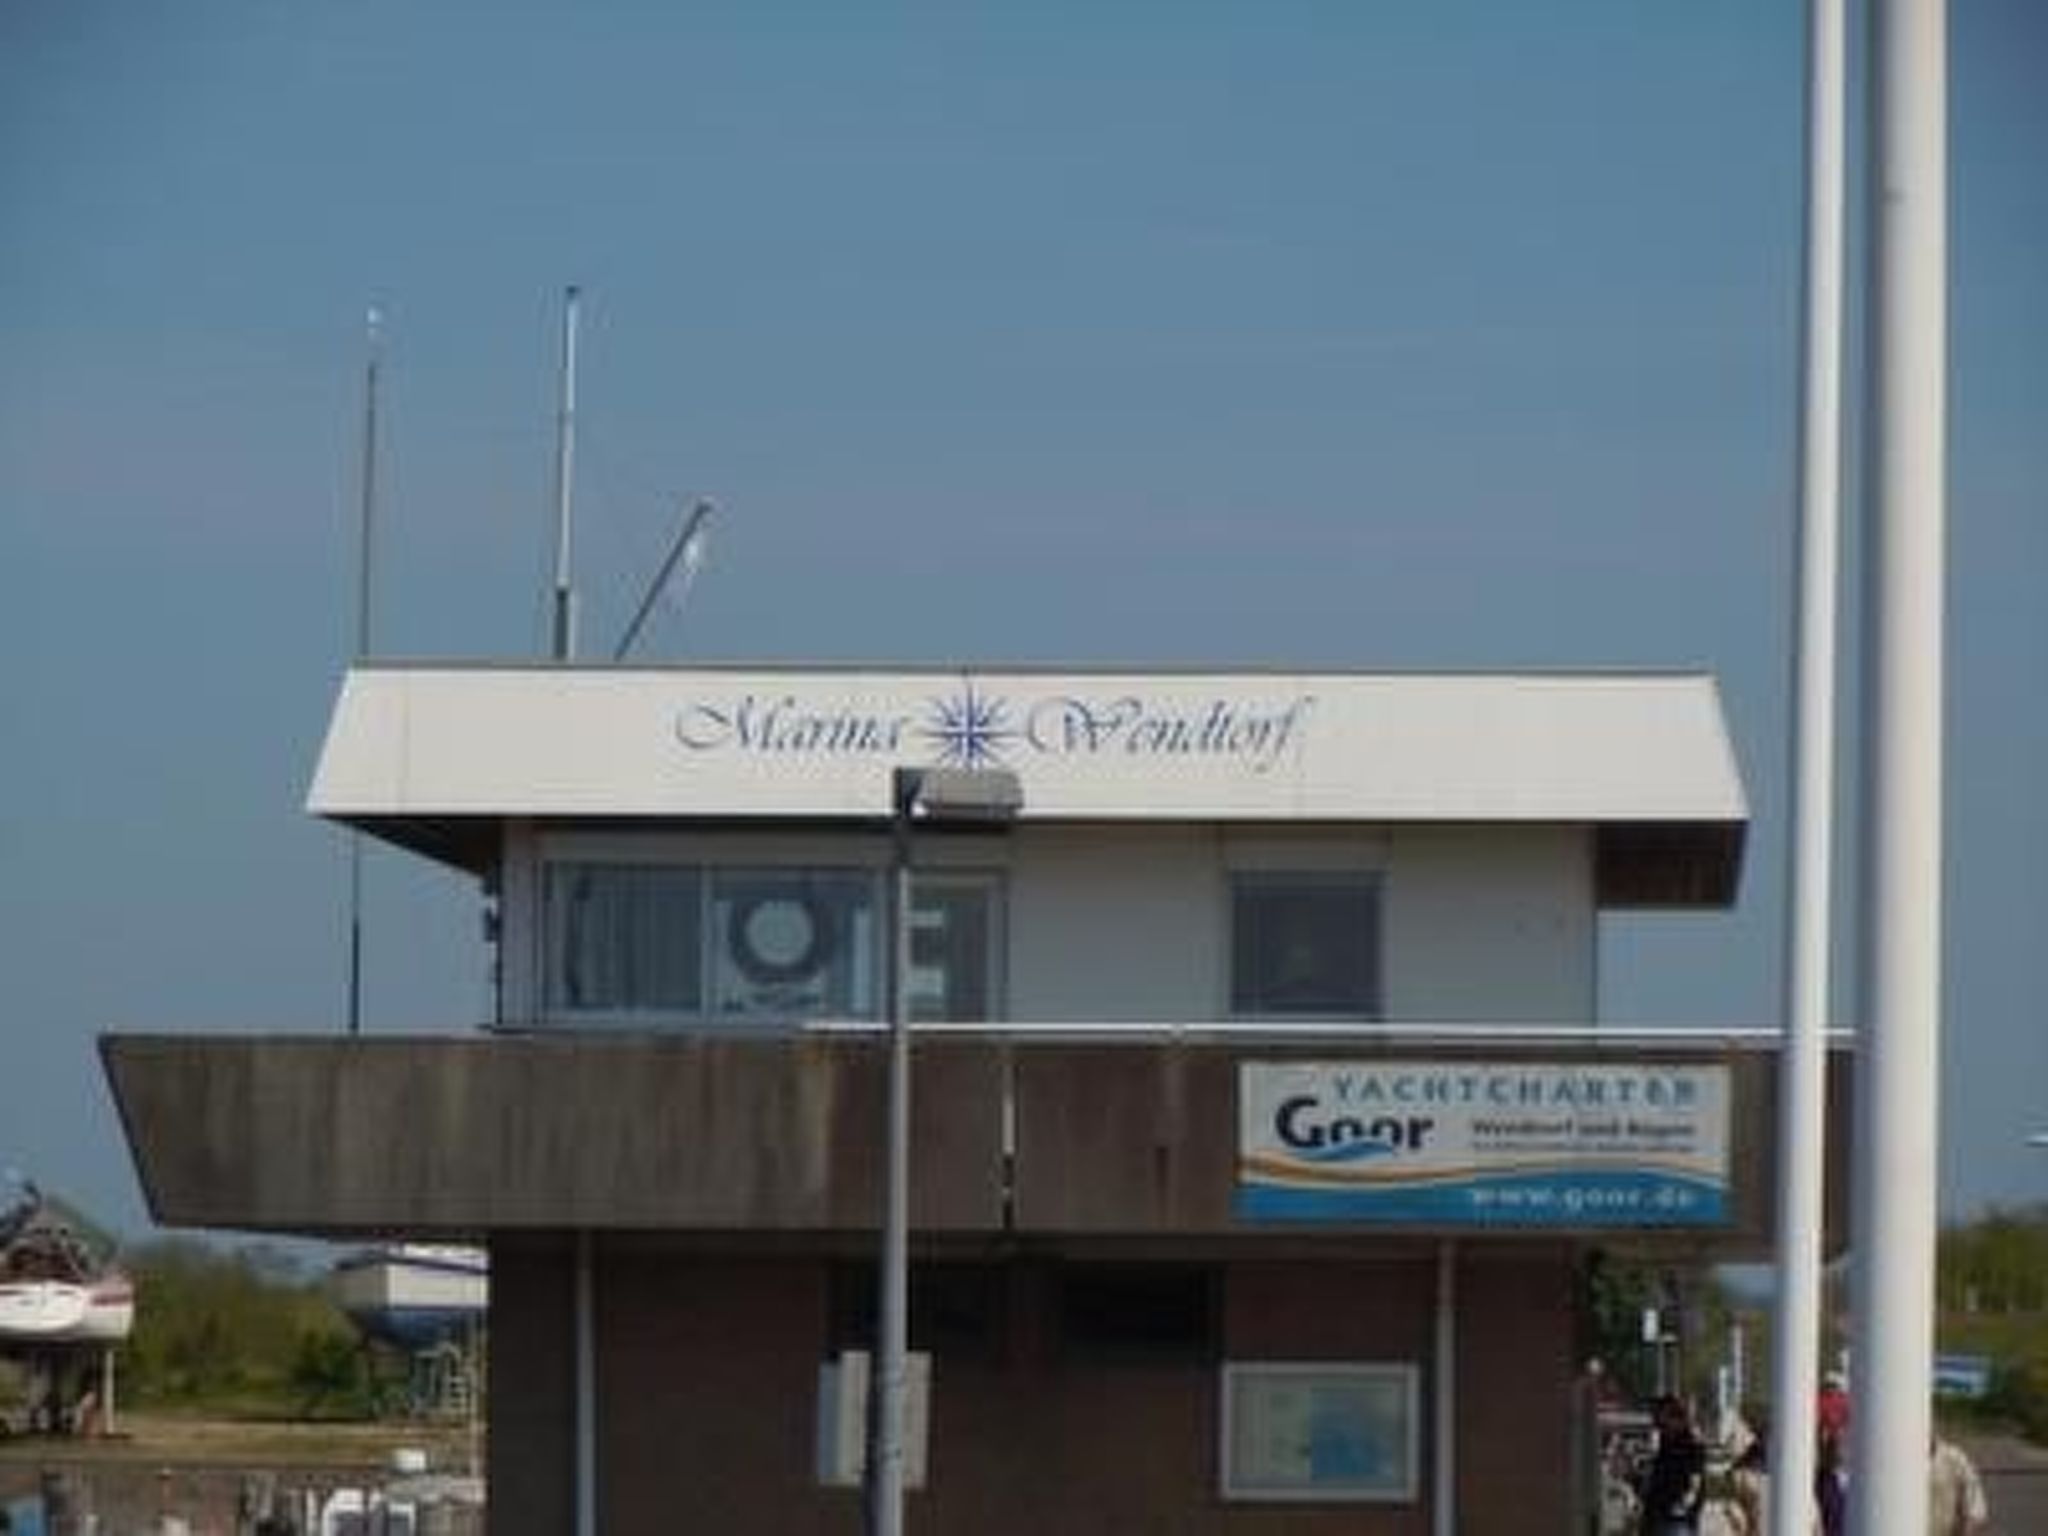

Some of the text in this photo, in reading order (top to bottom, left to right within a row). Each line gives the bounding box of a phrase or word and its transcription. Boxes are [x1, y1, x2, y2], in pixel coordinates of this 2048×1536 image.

[674, 694, 1315, 774] Marina Wendtorf
[1333, 1074, 1696, 1104] YACHTCHARTER
[1276, 1096, 1434, 1150] Goor
[1472, 1187, 1694, 1211] www.goor.de
